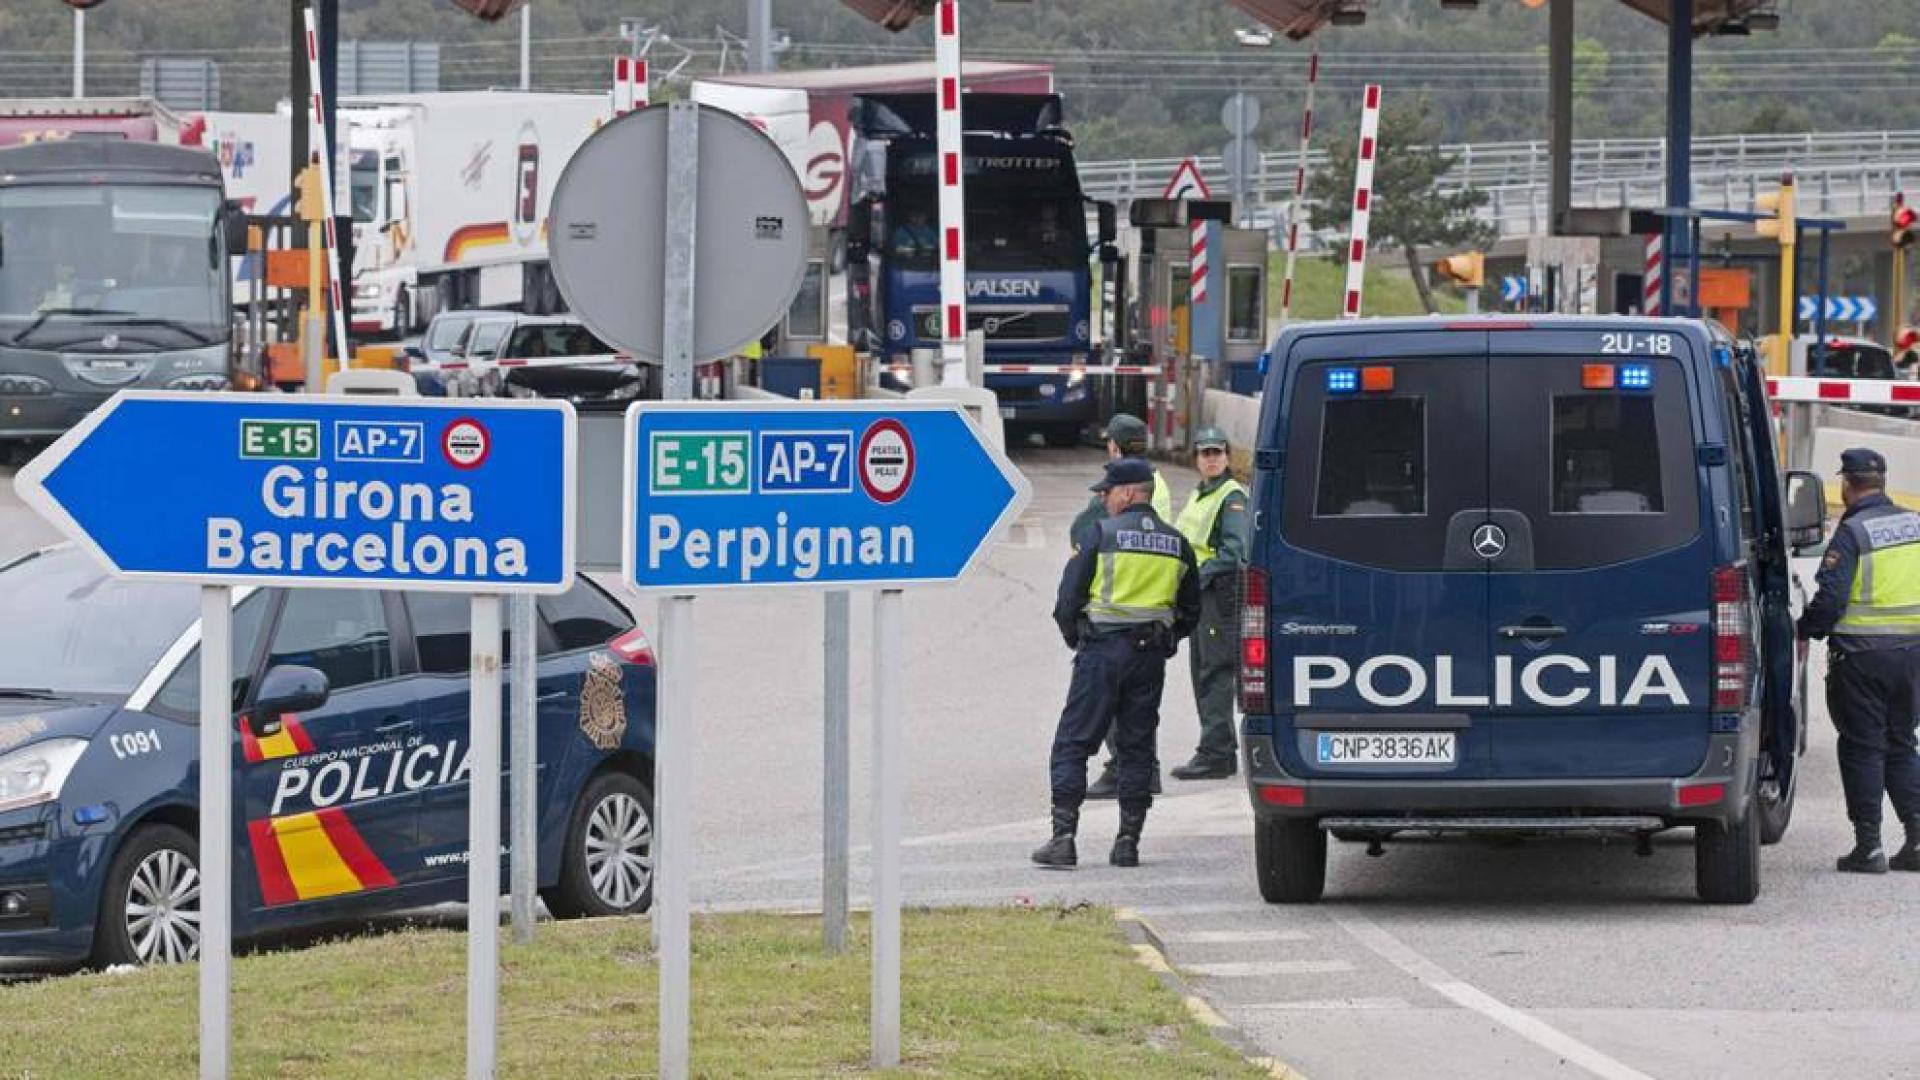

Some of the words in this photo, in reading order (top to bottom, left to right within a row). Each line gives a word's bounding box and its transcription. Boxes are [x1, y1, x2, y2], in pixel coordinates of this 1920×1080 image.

[940, 279, 1041, 297] VALSEN
[1602, 332, 1671, 354] 2U-18
[245, 425, 314, 454] E-15
[342, 427, 418, 456] AP-7
[656, 440, 745, 486] E-15
[766, 441, 847, 484] AP-7
[262, 464, 474, 523] Girona
[207, 517, 529, 577] Barcelona
[648, 511, 915, 582] Perpignan
[1120, 531, 1179, 552] POLICIA
[1871, 523, 1920, 545] POLICI
[1294, 655, 1690, 706] POLICIA
[283, 750, 337, 769] CUERPO
[339, 738, 404, 760] NACIONAL
[406, 735, 424, 748] DE
